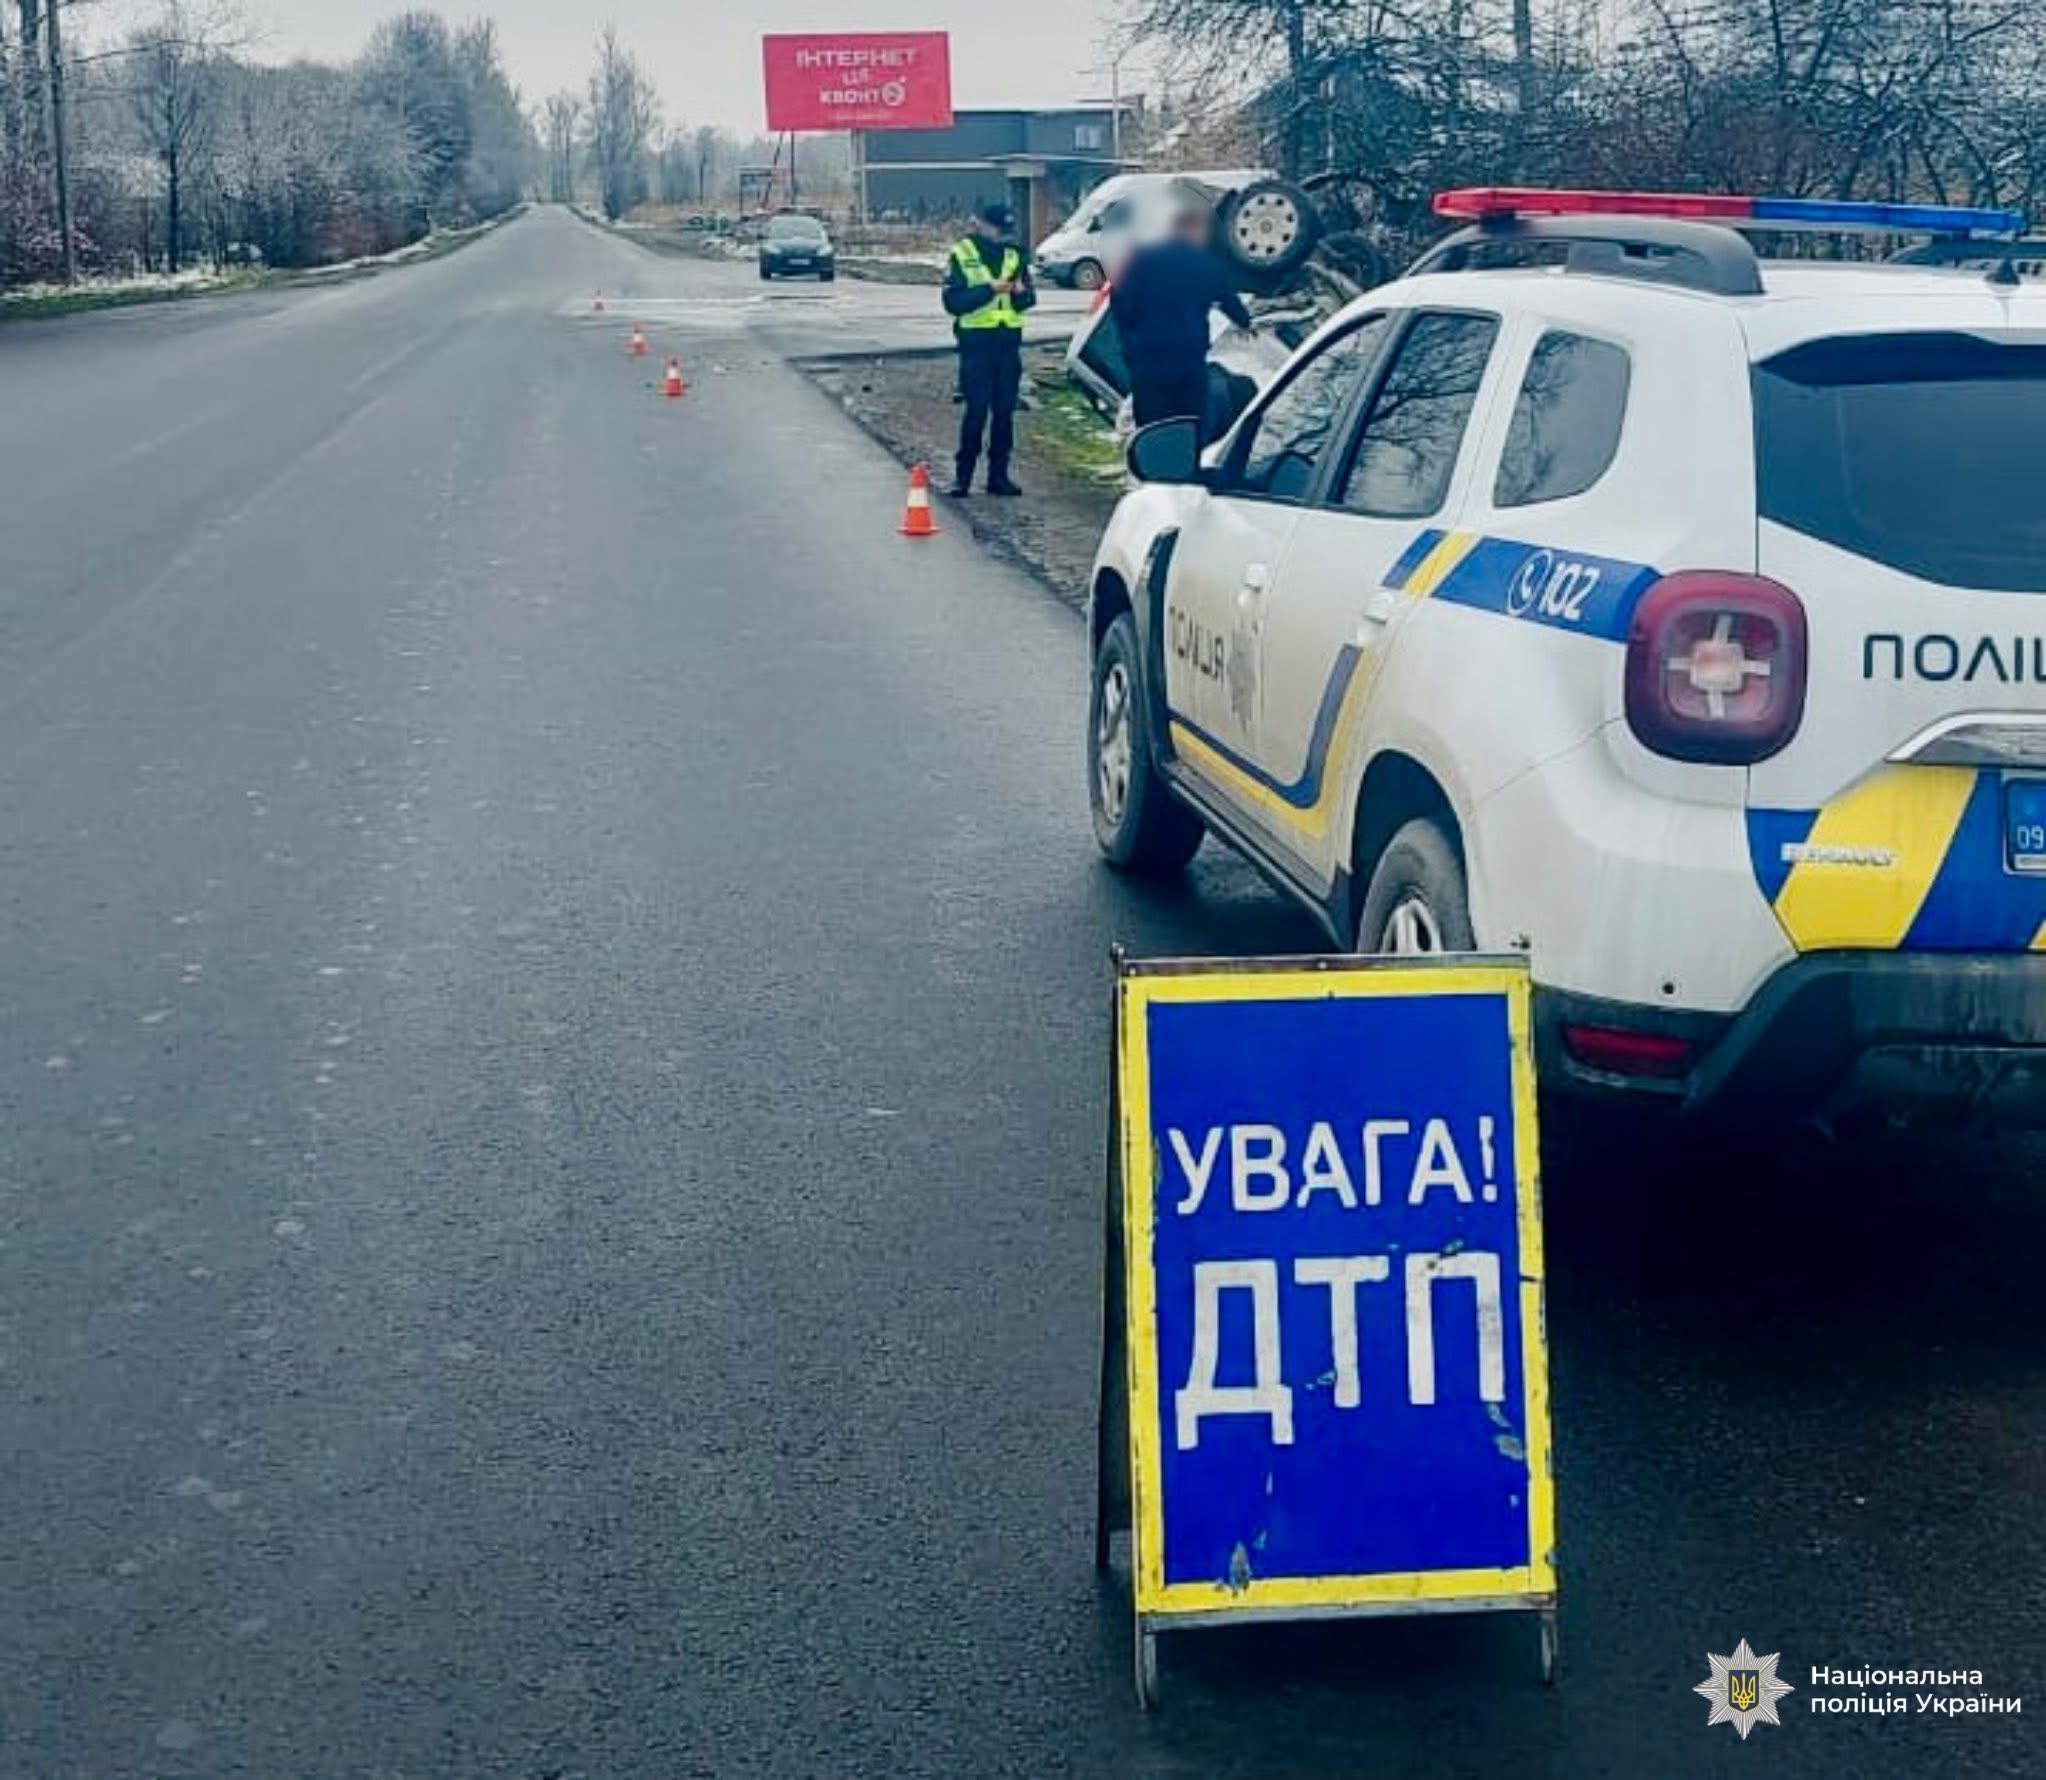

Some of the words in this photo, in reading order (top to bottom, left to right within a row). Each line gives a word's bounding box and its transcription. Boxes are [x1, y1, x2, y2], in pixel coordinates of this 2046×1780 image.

[1537, 561, 1600, 622] 102
[1863, 633, 2046, 684] ПОЛІ
[1168, 1115, 1498, 1215] УВАГА!
[1174, 1251, 1506, 1451] ДТП
